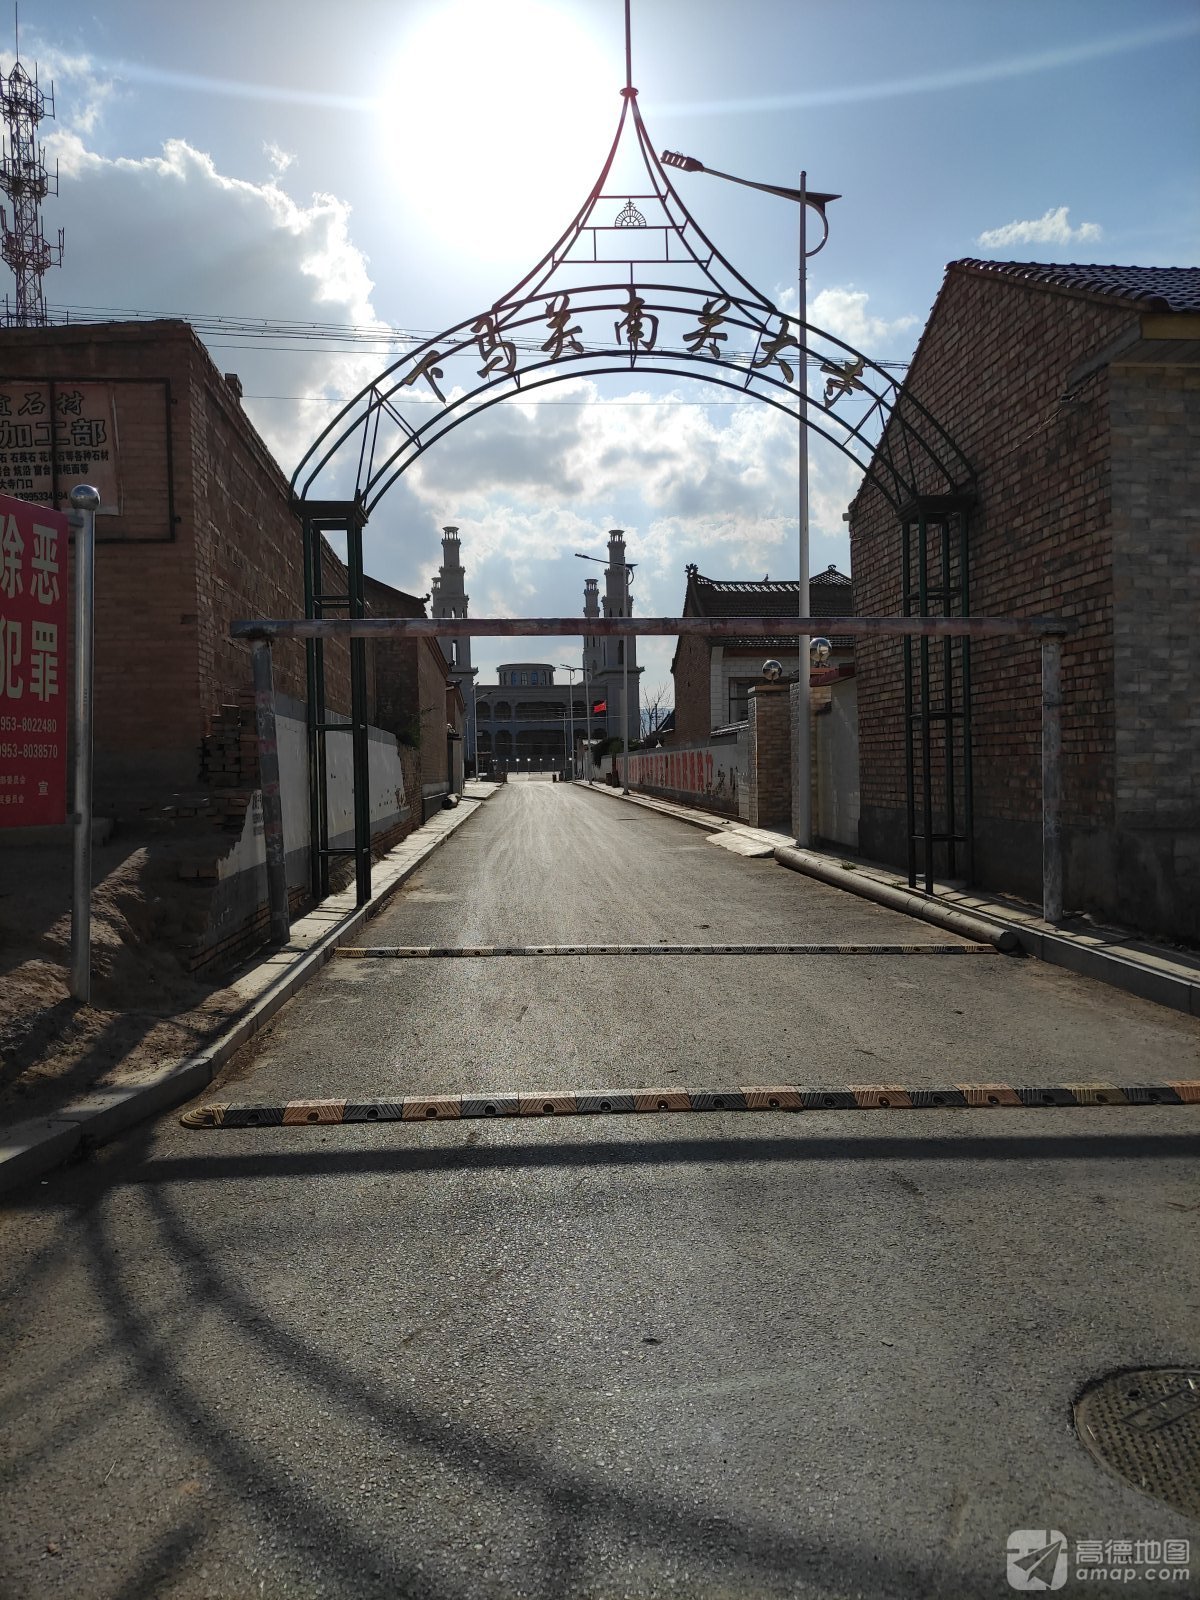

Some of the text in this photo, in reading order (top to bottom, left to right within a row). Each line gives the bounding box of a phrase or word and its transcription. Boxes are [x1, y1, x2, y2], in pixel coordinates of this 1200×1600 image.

[0, 418, 107, 449] 加工部
[39, 450, 109, 463] 花石等各种石材
[0, 514, 60, 605] 除恶
[0, 614, 59, 702] 犯罪
[0, 716, 57, 733] 953-8022480
[0, 743, 58, 759] 953-8038570
[38, 780, 49, 796] 宣
